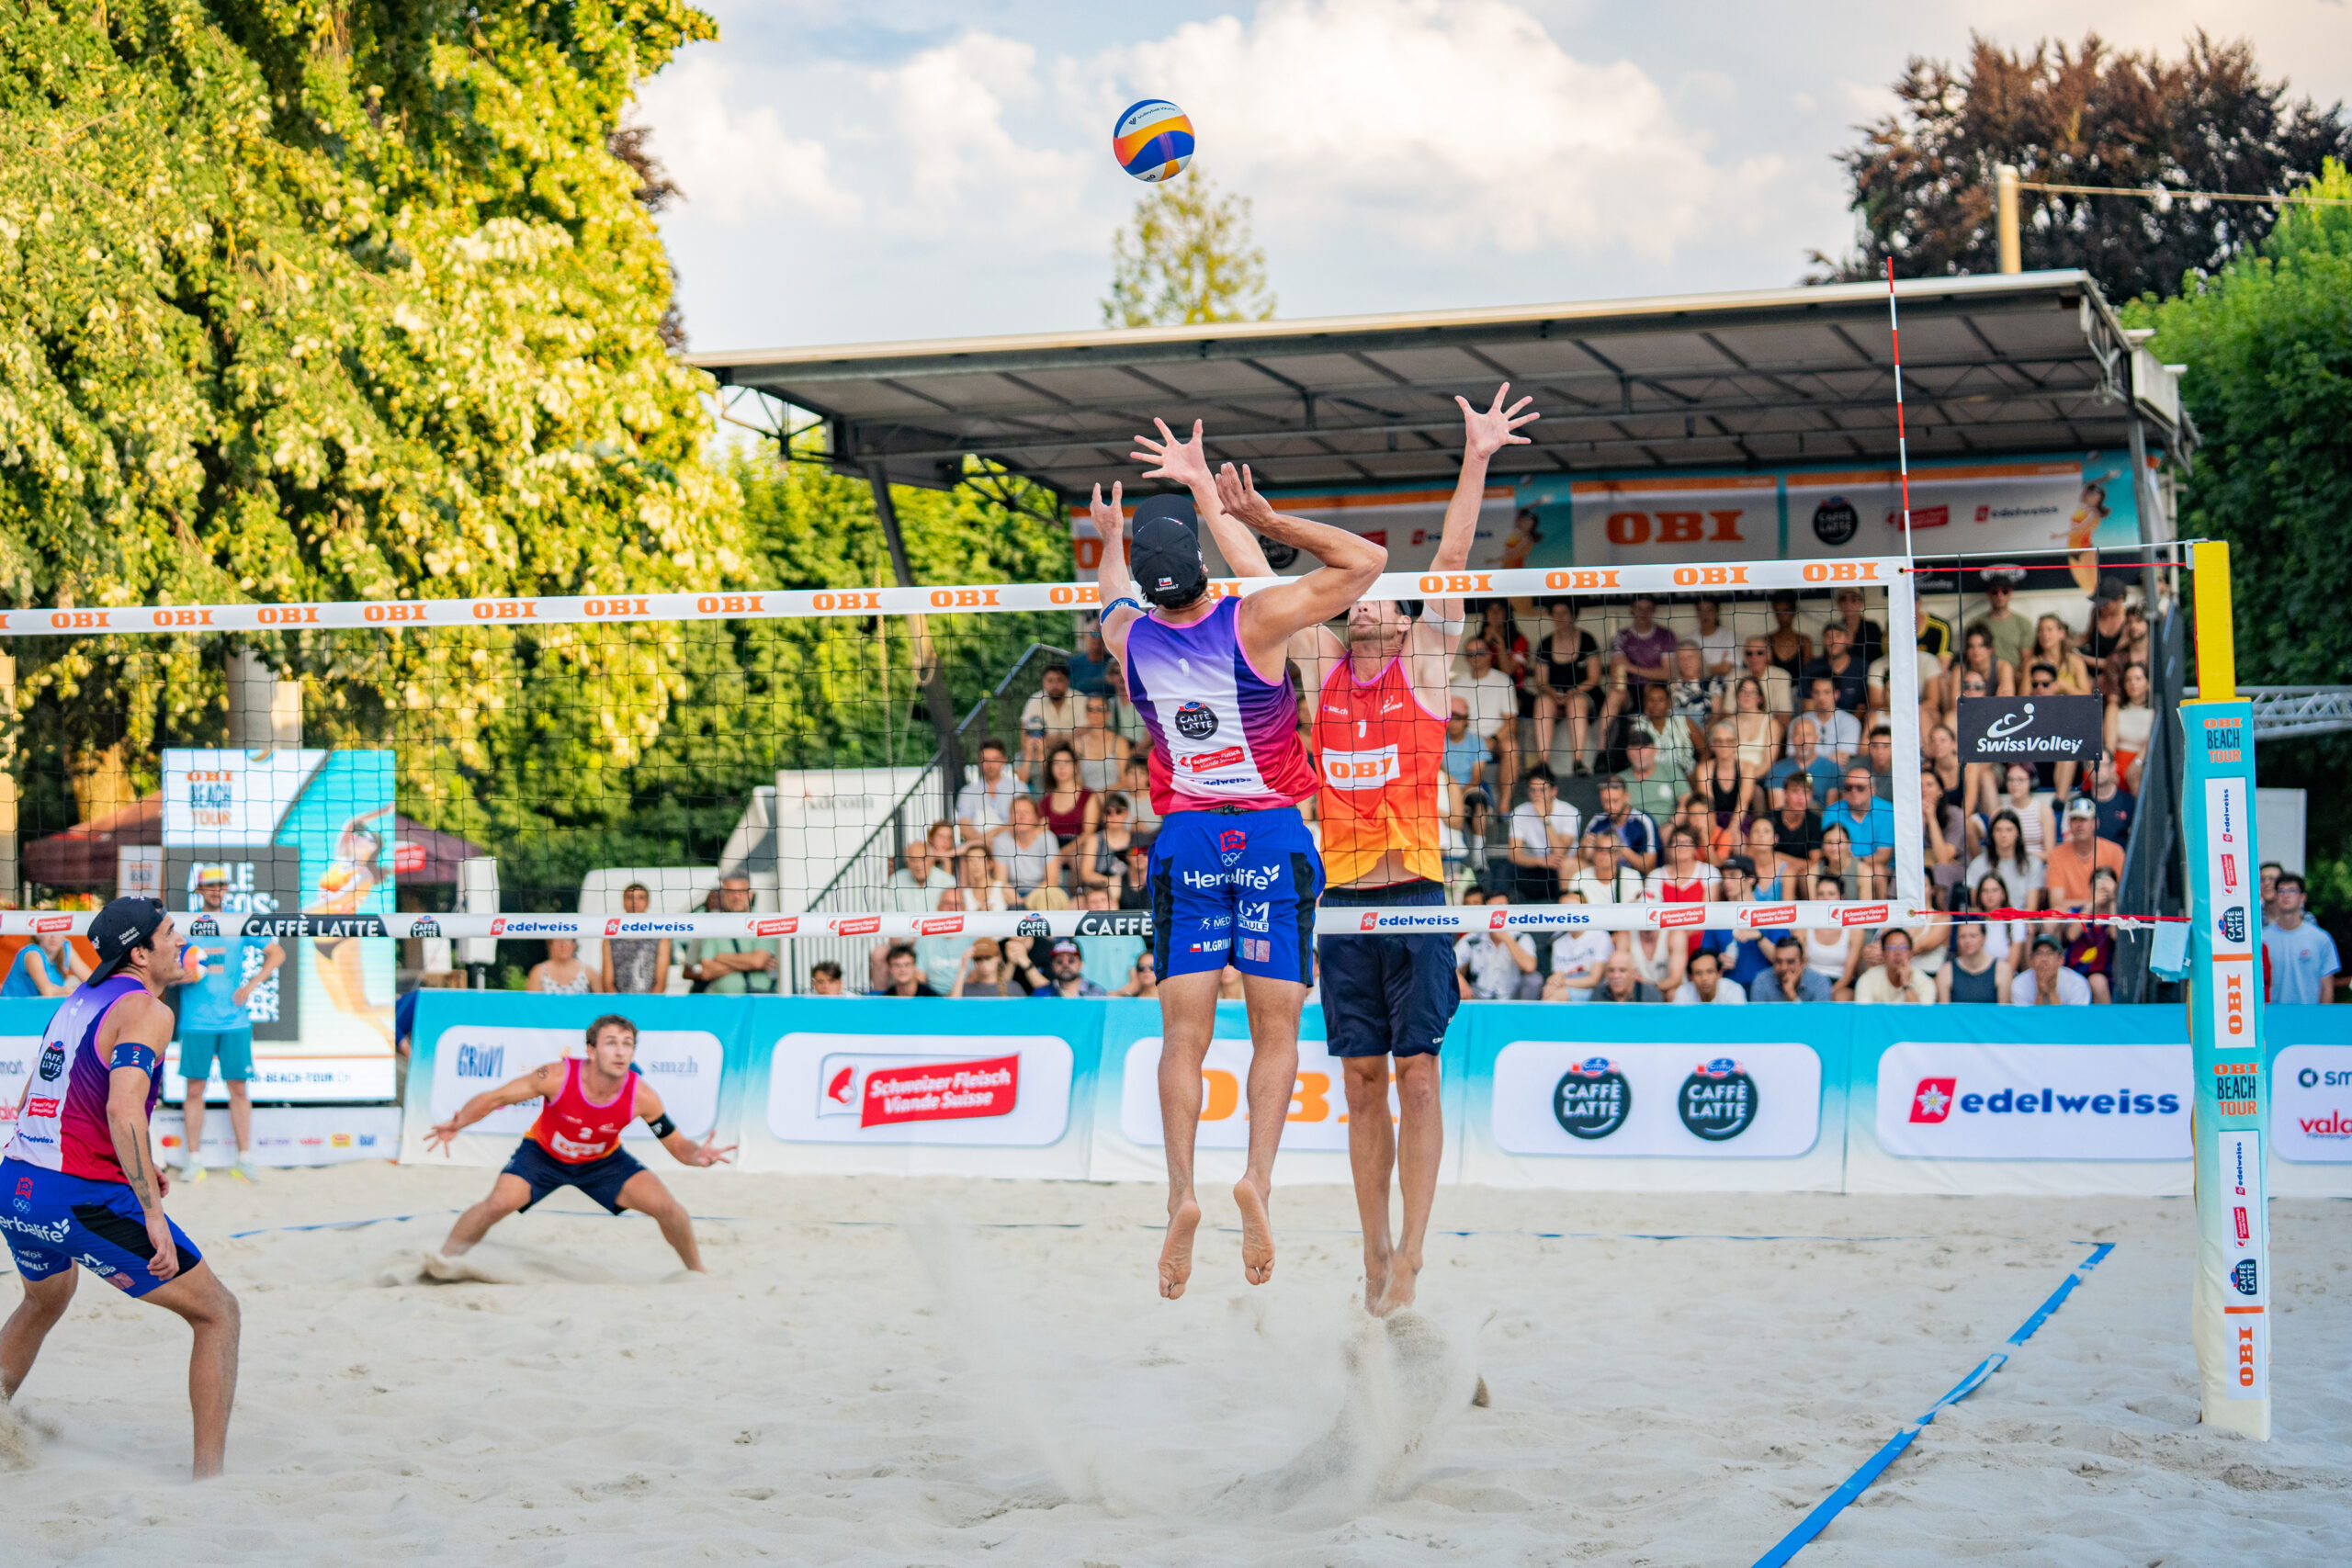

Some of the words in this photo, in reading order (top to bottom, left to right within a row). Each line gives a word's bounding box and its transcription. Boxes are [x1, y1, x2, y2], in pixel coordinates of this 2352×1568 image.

[1606, 510, 1744, 545] OBI
[1545, 570, 1620, 589] OBI
[1674, 567, 1748, 585] OBI
[1804, 563, 1878, 581] OBI
[1207, 581, 1243, 599] BI
[1419, 574, 1492, 592] OBI
[813, 592, 881, 610] OBI
[931, 590, 1000, 607] OBI
[1050, 587, 1100, 604] OB
[365, 604, 426, 621] OBI
[473, 603, 537, 618] OBI
[584, 599, 650, 616] OBI
[697, 596, 764, 613] OBI
[51, 613, 110, 628] OBI
[153, 610, 213, 626] OBI
[257, 607, 319, 624] OBI
[1180, 711, 1211, 724] CAFFÈ
[1182, 721, 1213, 731] LATTE
[2203, 717, 2242, 728] OBI
[1358, 719, 1367, 738] 1
[1977, 736, 2083, 754] SwissVolley
[2207, 728, 2240, 749] BEACH
[2208, 750, 2242, 762] TOUR
[187, 771, 232, 781] OBI
[245, 914, 309, 936] CAFFÈ
[317, 919, 379, 936] LATTE
[507, 922, 577, 931] edelweiss
[622, 922, 694, 931] edelweiss
[1020, 920, 1047, 930] CAFFÈ
[1082, 911, 1153, 935] CAFFÈ
[1379, 916, 1459, 925] edelweiss
[1509, 914, 1589, 924] edelweiss
[2225, 910, 2235, 940] CAFFÈ
[2227, 974, 2243, 1035] OBI
[132, 1050, 140, 1059] 2
[2213, 1063, 2258, 1075] OBI
[869, 1075, 953, 1098] Schweizer
[952, 1067, 1011, 1090] Fleisch
[1563, 1078, 1622, 1100] CAFFÈ
[1687, 1079, 1748, 1101] CAFFÈ
[2217, 1076, 2256, 1100] BEACH
[883, 1092, 941, 1115] Viande
[940, 1089, 994, 1110] Suisse
[1563, 1100, 1621, 1117] LATTE
[1689, 1101, 1747, 1118] LATTE
[1961, 1089, 2178, 1114] edelweiss
[2218, 1100, 2257, 1116] TOUR
[579, 1127, 593, 1139] 2
[2237, 1262, 2247, 1292] CAFFÈ
[2247, 1263, 2256, 1292] LATTE
[2239, 1326, 2254, 1387] OBI
